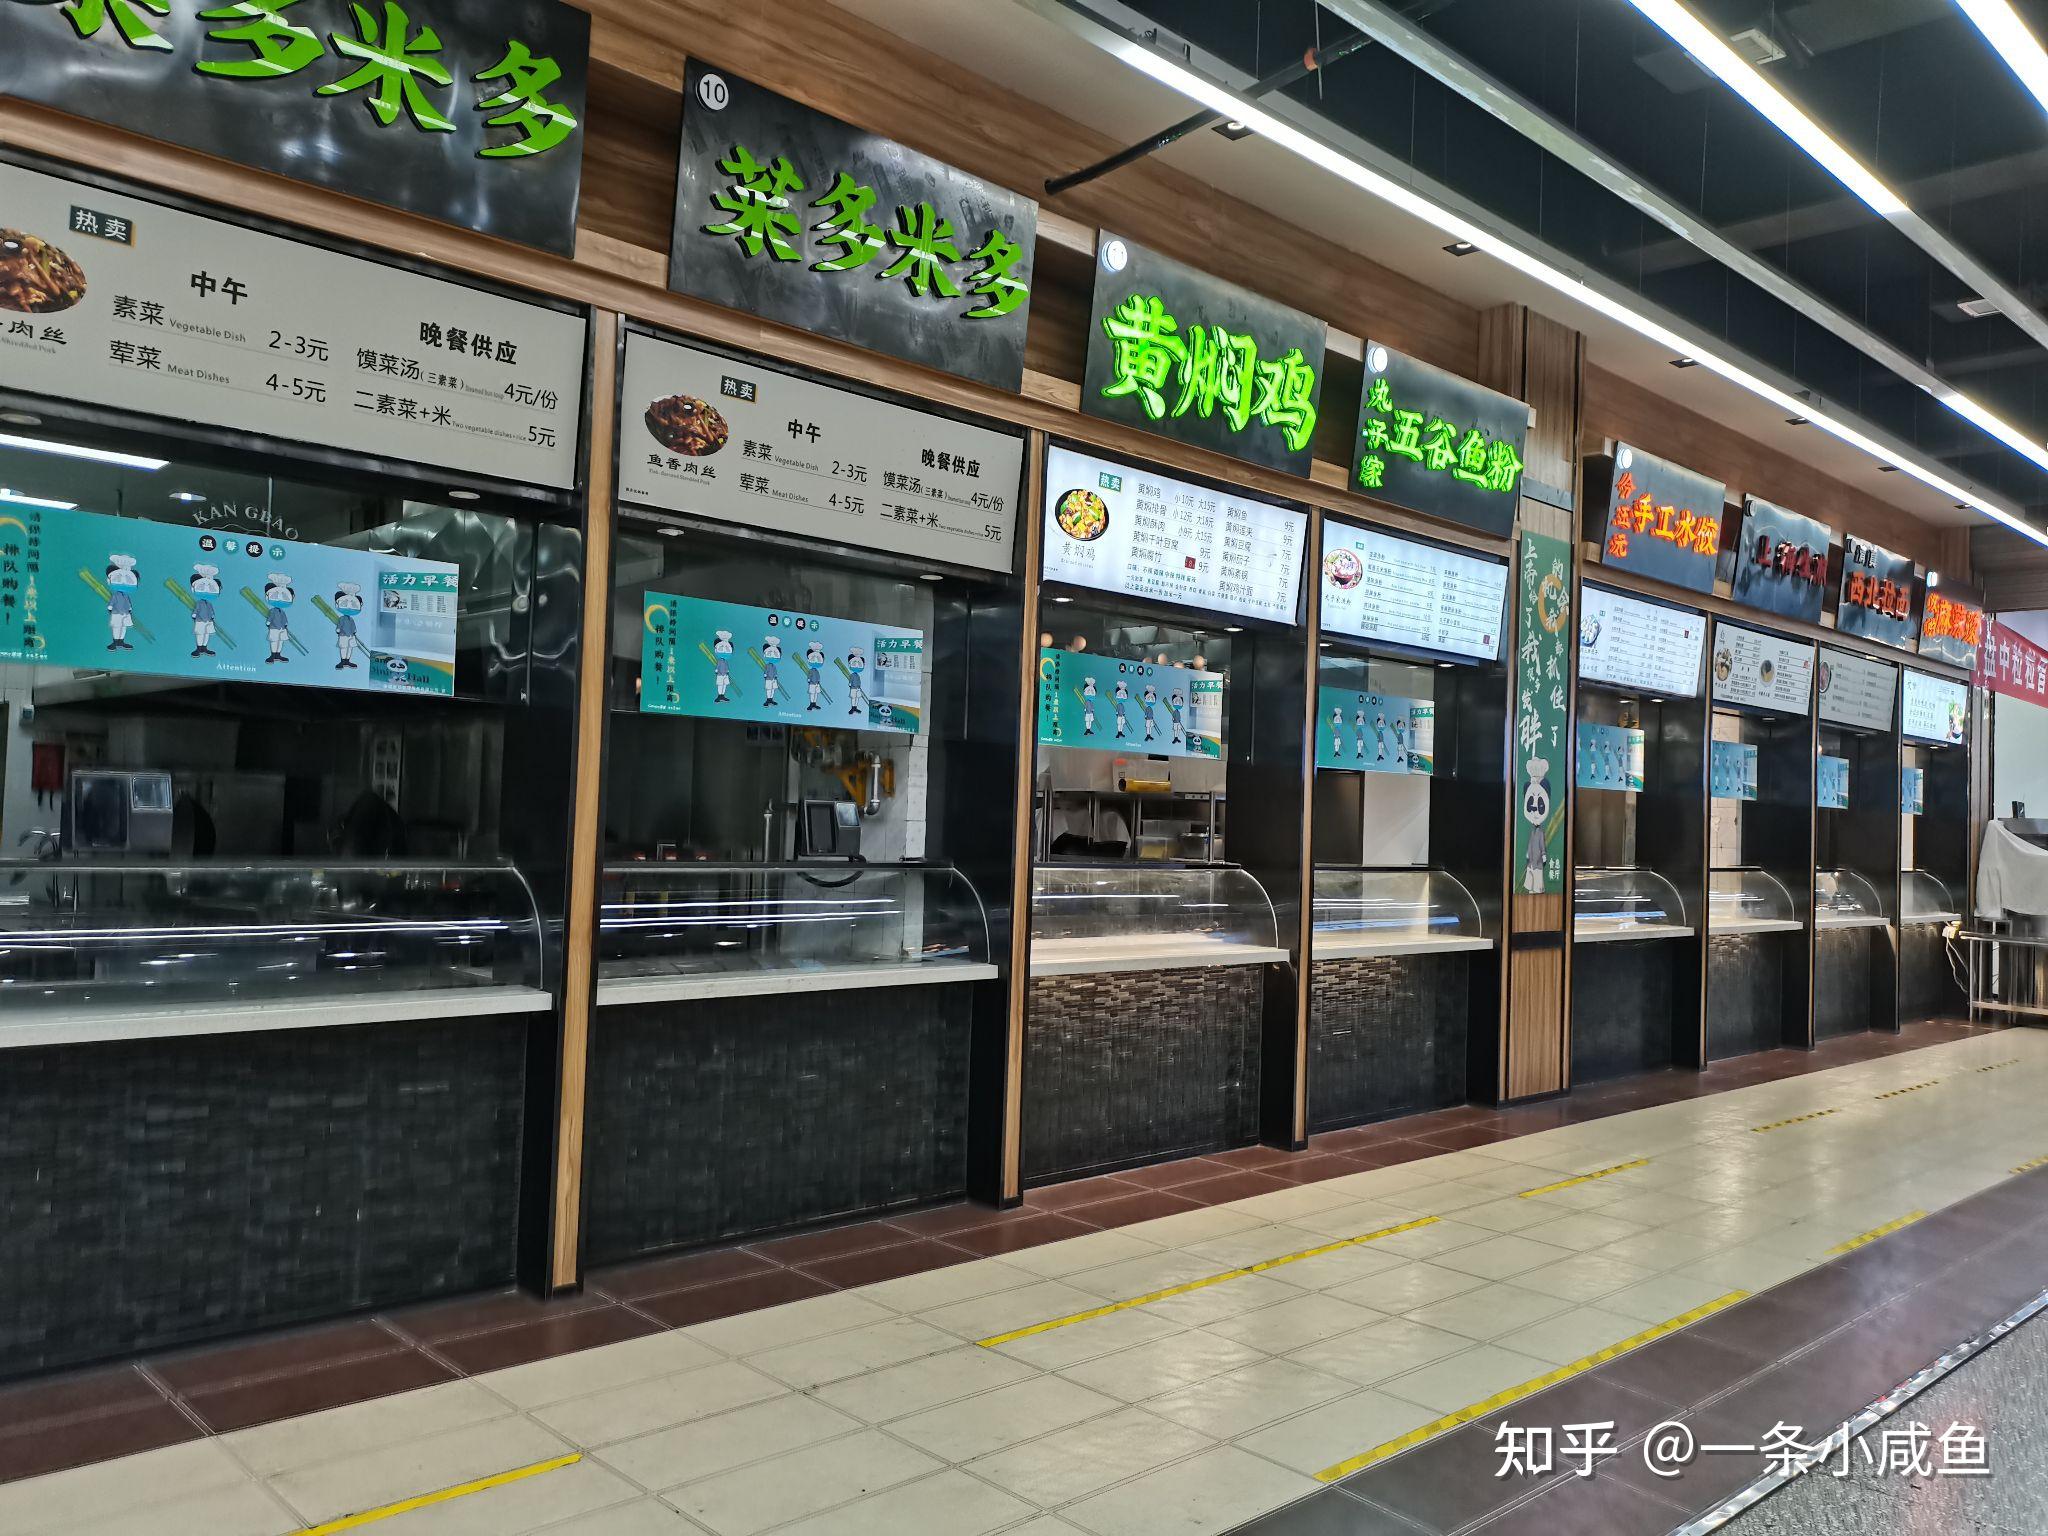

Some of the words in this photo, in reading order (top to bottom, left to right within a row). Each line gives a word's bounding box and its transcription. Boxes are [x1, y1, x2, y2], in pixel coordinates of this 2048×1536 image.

[703, 79, 726, 103] 10
[76, 209, 127, 241] 热卖
[701, 145, 1029, 318] 菜多米多
[191, 270, 248, 305] 中午
[0, 320, 68, 346] 肉丝
[112, 295, 165, 326] 素菜
[169, 317, 222, 338] Vegetable
[223, 329, 246, 343] Dish
[268, 330, 329, 362] 2-3元
[420, 322, 518, 366] 晚餐供应
[110, 340, 162, 370] 荤菜
[167, 363, 195, 377] Meat
[196, 369, 231, 384] Dishes
[265, 373, 326, 404] 4-5元
[1102, 294, 1318, 452] 黄焖鸡
[504, 383, 559, 411] 4元/份
[724, 379, 754, 401] 热卖
[353, 389, 451, 427] 二素菜+米
[528, 426, 556, 448] 5元
[787, 419, 822, 444] 中午
[1361, 379, 1394, 489] 丸子家
[647, 454, 716, 479] 鱼香肉丝
[743, 440, 773, 462] 素菜
[774, 455, 806, 470] Vegetable
[805, 461, 819, 472] Dish
[831, 460, 867, 483] 2-3元
[921, 448, 981, 479] 晚餐供应
[1390, 408, 1524, 494] 五谷鱼粉
[740, 473, 770, 495] 荤菜
[772, 488, 789, 499] Meat
[789, 492, 809, 503] Dishes
[829, 493, 865, 514] 4-5元
[970, 492, 1004, 513] 4元/份
[984, 525, 1002, 542] 5元
[1633, 493, 1719, 556] 手工水饺
[201, 537, 284, 557] 温馨提示
[383, 573, 458, 587] 活力早餐
[876, 639, 922, 650] 活力早餐
